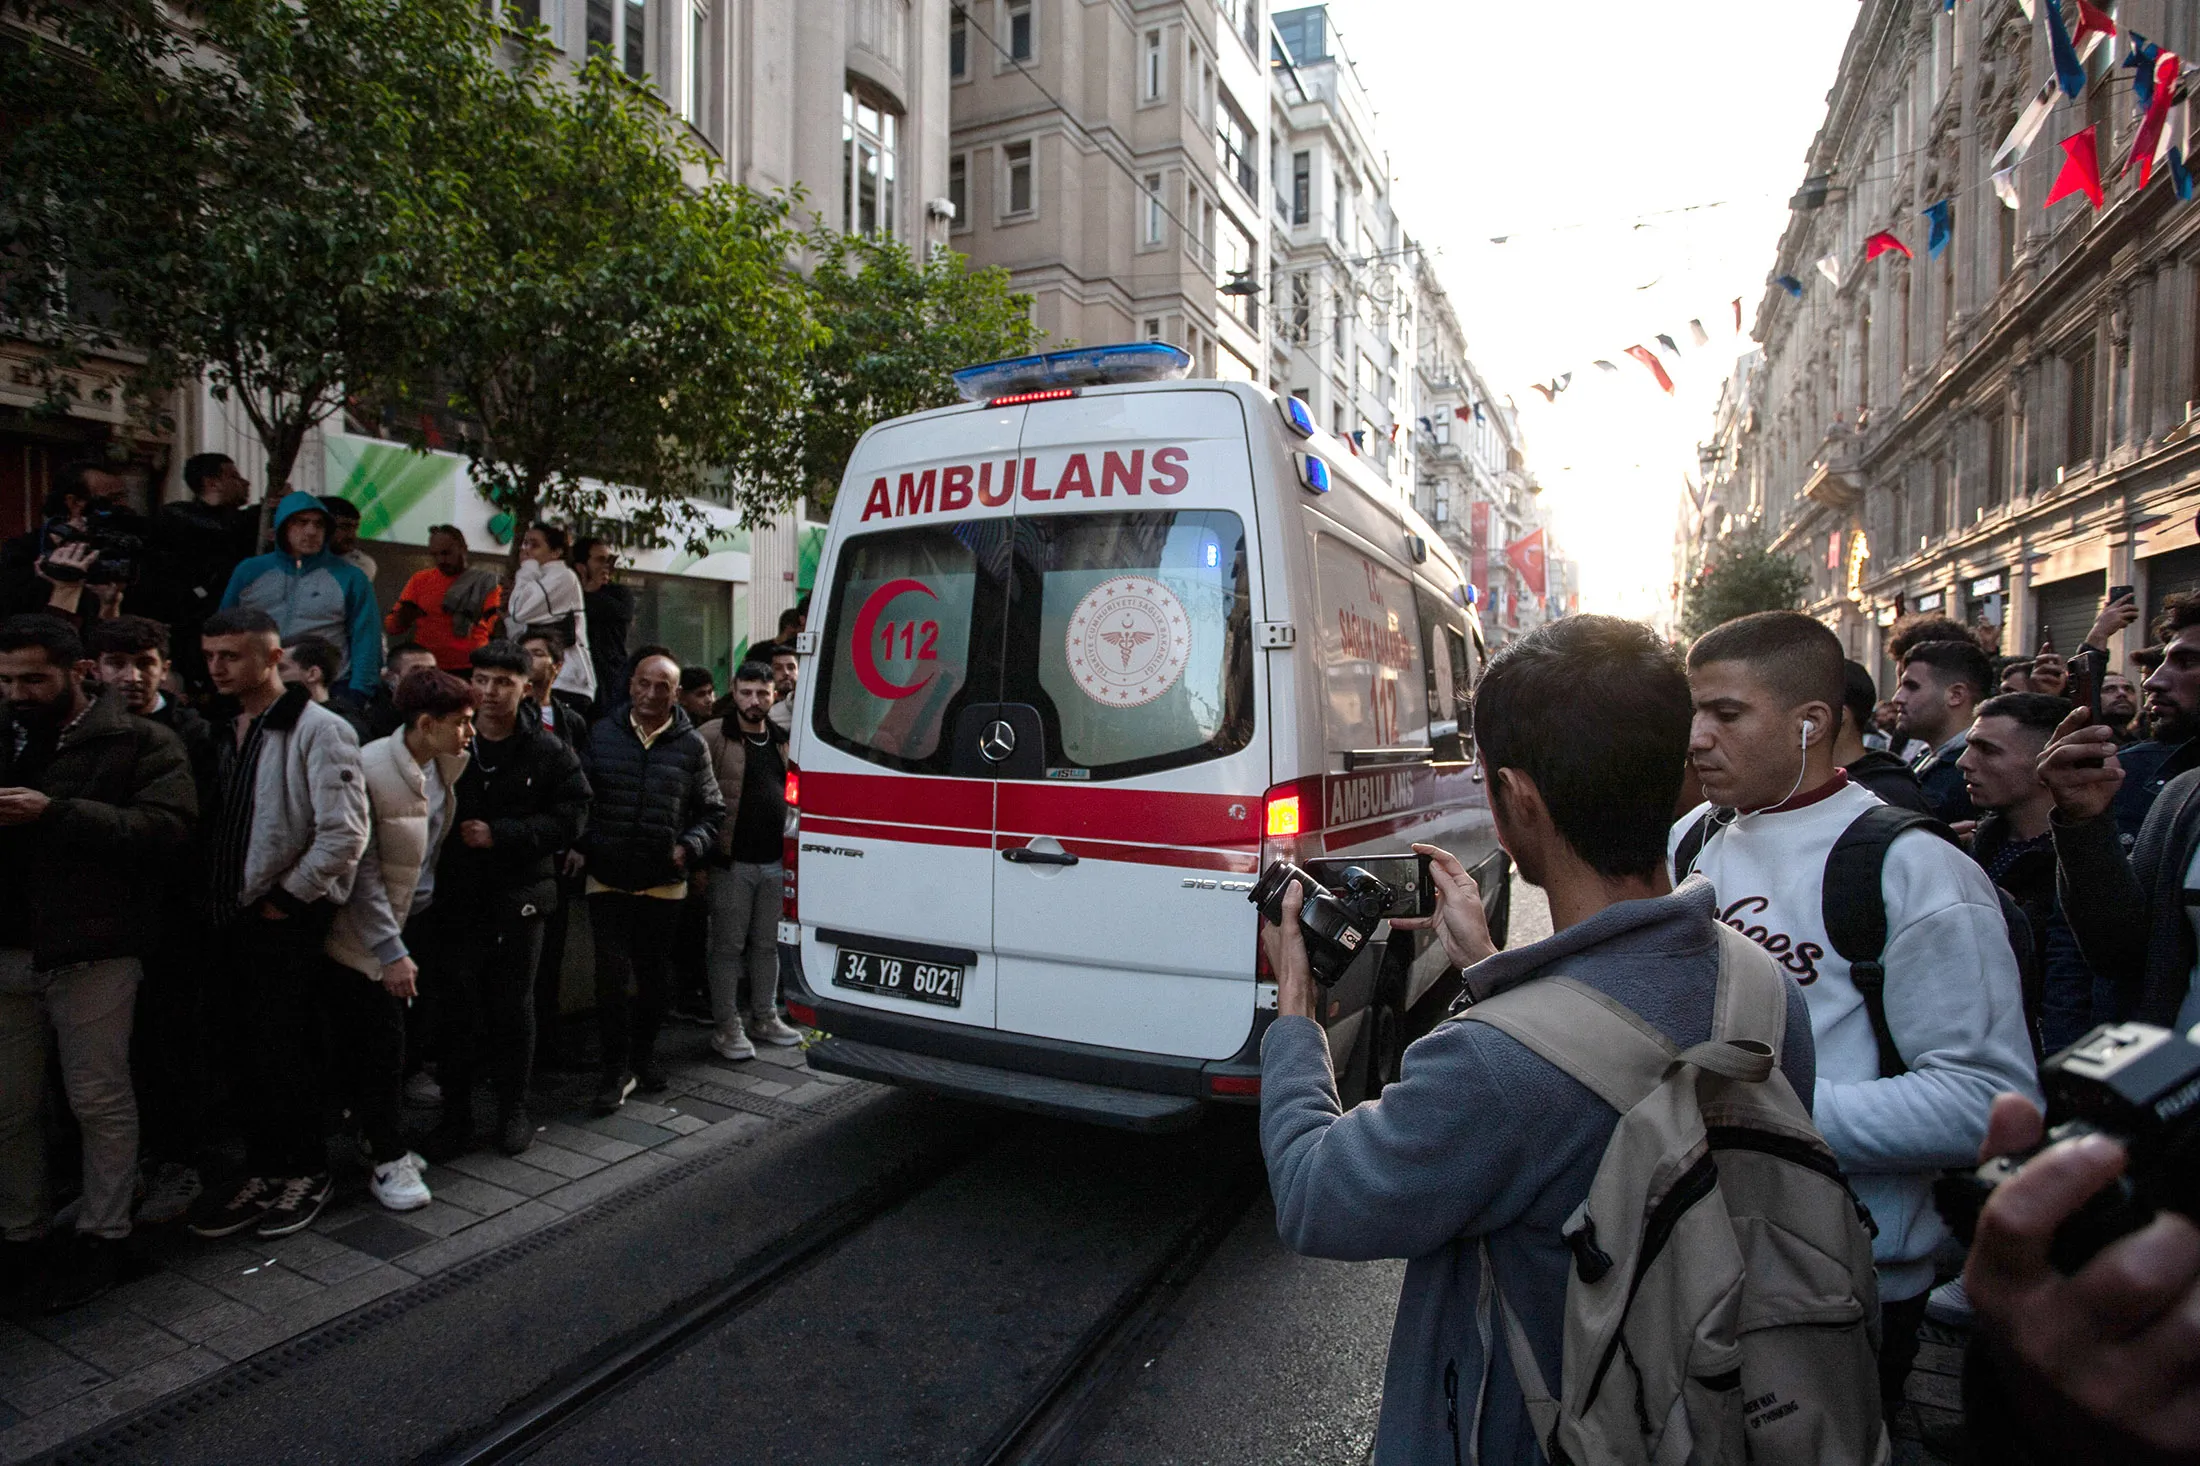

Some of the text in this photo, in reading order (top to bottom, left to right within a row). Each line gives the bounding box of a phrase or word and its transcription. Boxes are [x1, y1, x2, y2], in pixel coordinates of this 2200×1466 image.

[861, 447, 1189, 521] AMBULANS
[880, 620, 939, 661] 112
[1370, 674, 1400, 746] 112
[1330, 769, 1414, 825] AMBULANS
[800, 843, 865, 859] SPRINTER
[845, 954, 868, 982] 34
[879, 959, 903, 987] YB
[913, 965, 960, 998] 6021
